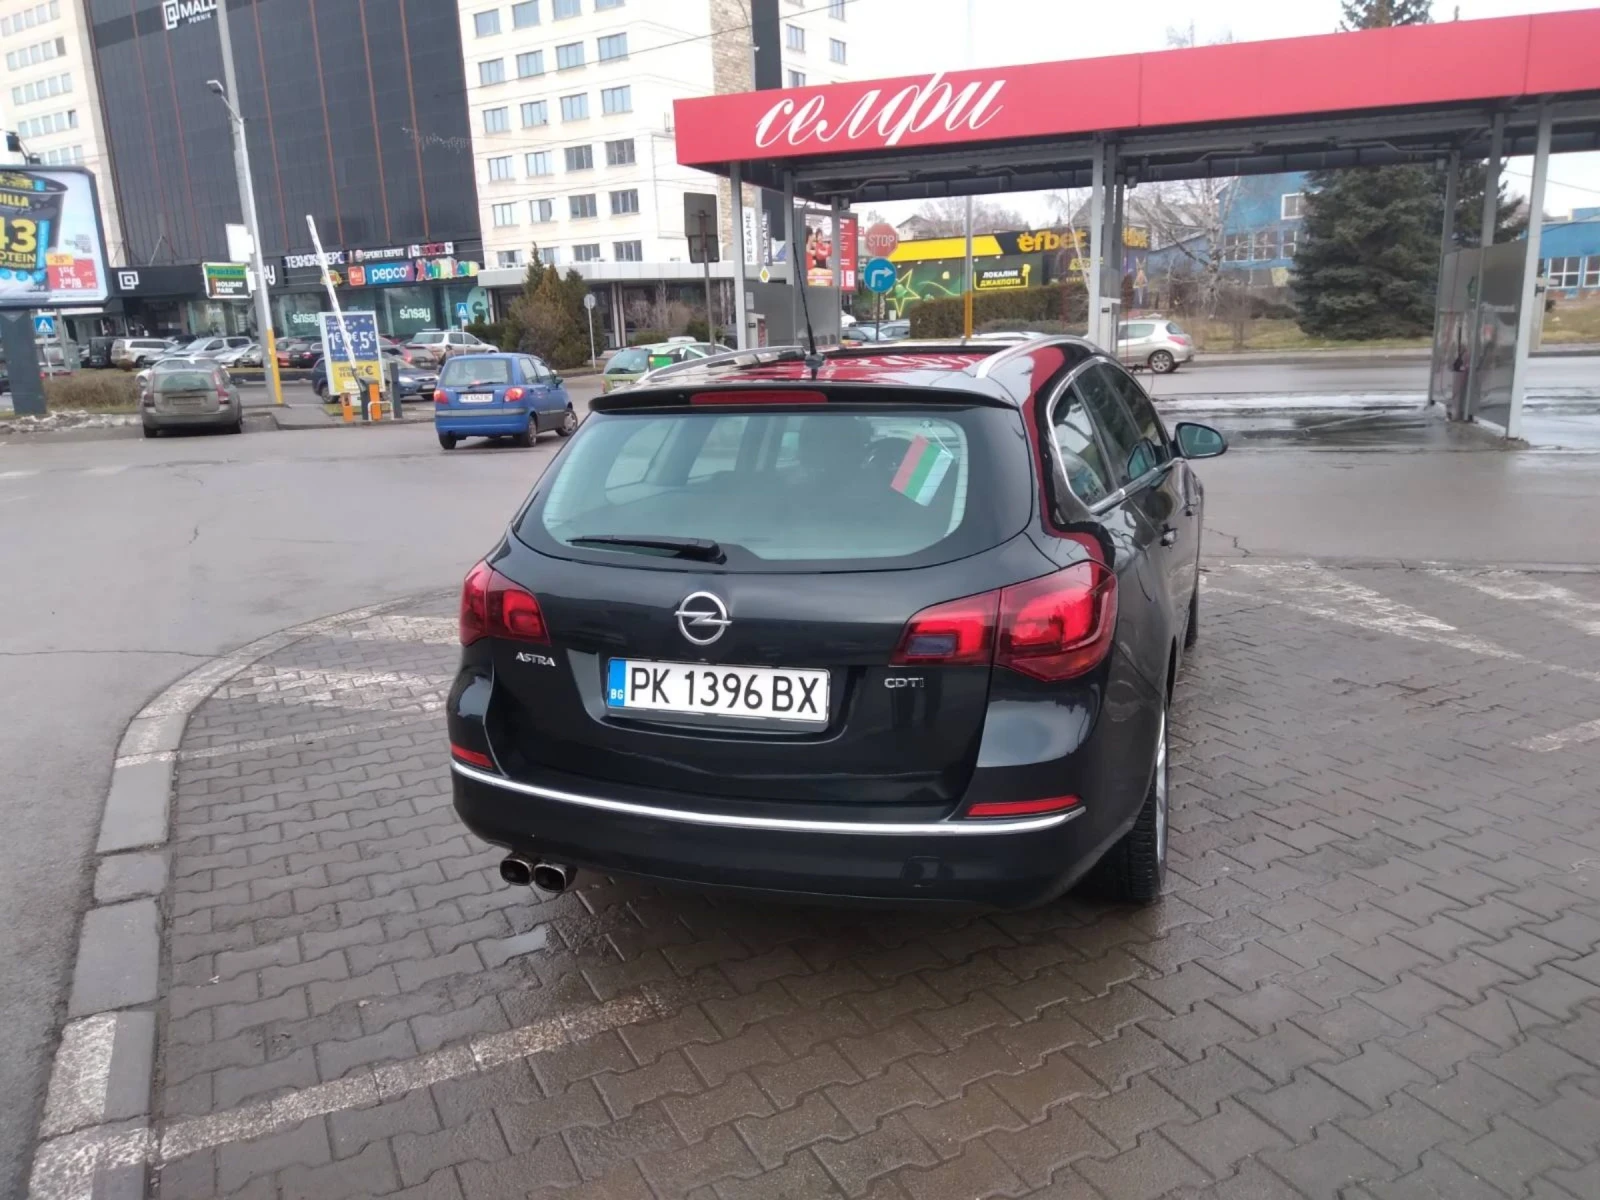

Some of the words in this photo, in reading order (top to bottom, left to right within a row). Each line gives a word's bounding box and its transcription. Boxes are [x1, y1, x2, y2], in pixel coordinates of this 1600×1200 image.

[745, 211, 753, 263] SESAME
[868, 234, 895, 247] STOP
[1017, 228, 1088, 252] efbet
[364, 251, 383, 259] SPORT
[384, 248, 404, 257] DEPOT
[371, 266, 407, 283] pepco
[982, 269, 1019, 279] ЛОКАЛНИ
[400, 305, 431, 322] sinsay
[515, 651, 556, 667] ASTRA
[610, 688, 625, 700] BG
[630, 667, 671, 704] PK
[684, 670, 763, 710] 1396
[771, 675, 820, 714] BX
